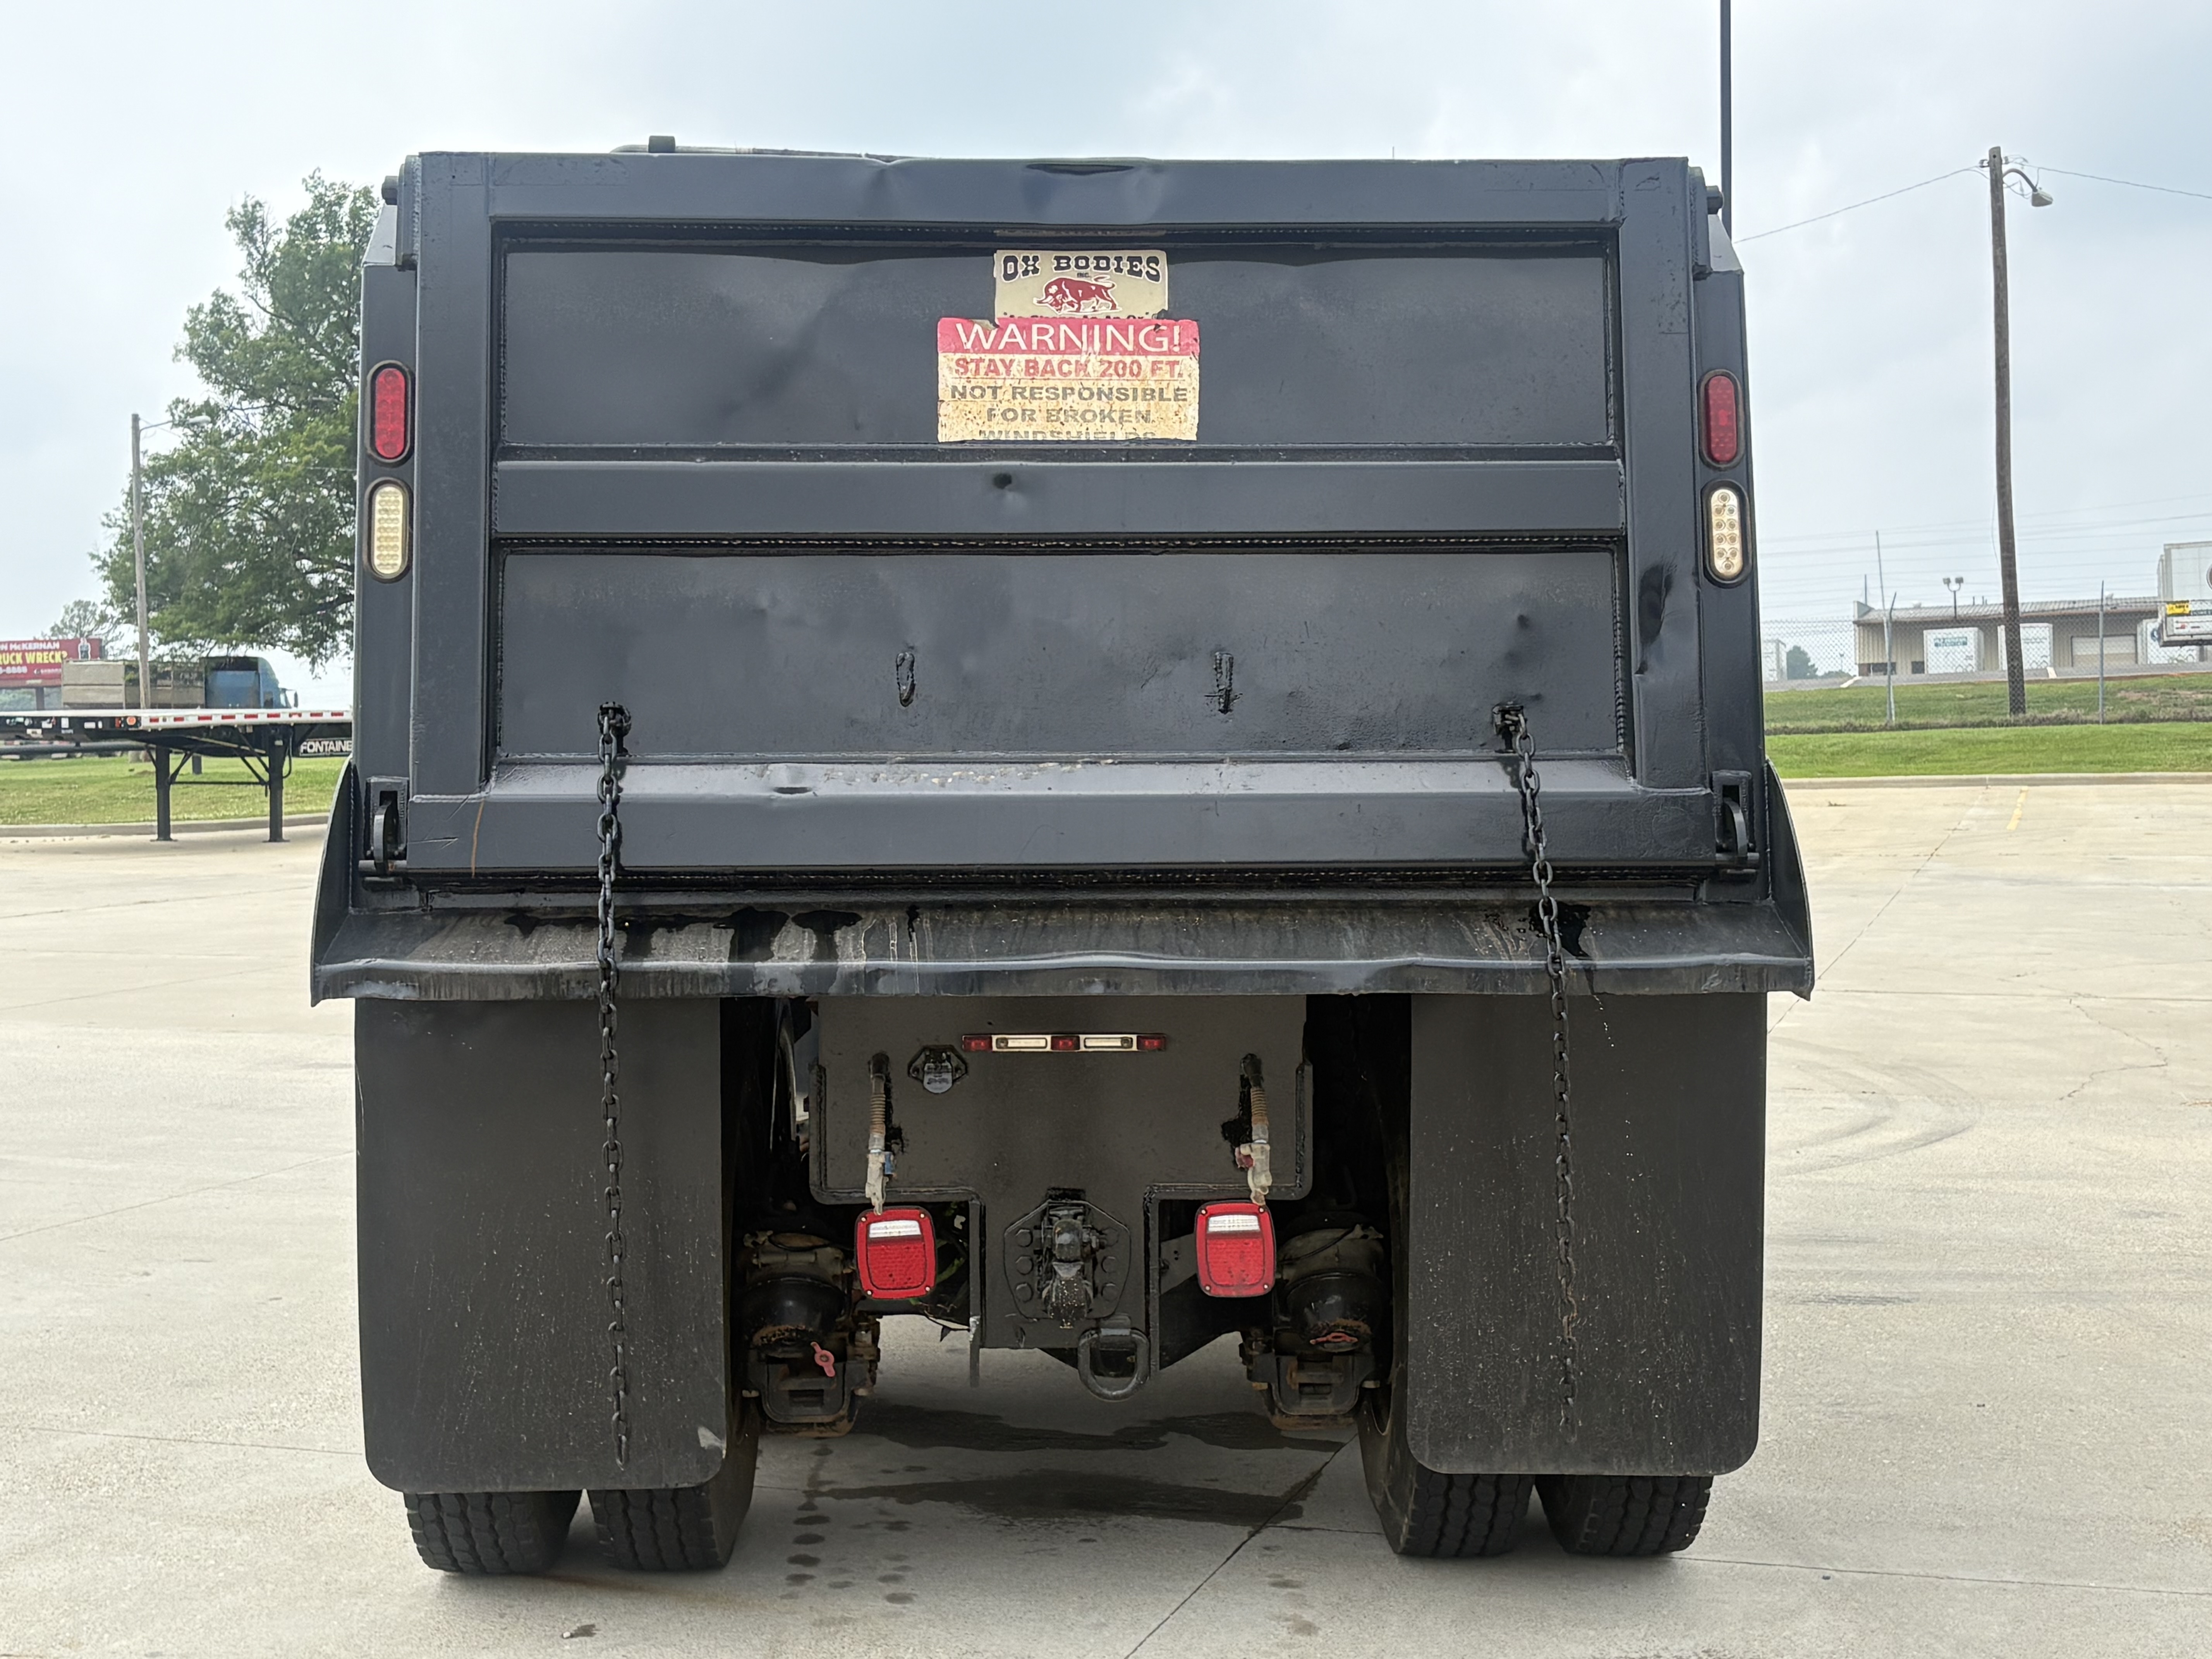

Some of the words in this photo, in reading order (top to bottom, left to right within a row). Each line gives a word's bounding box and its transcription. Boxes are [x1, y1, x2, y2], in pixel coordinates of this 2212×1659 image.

[1003, 255, 1040, 281] OX
[1053, 255, 1160, 282] BODIES
[955, 323, 1180, 352] WARNING!
[955, 357, 1015, 376] STAY
[1024, 359, 1091, 377] BACK
[1100, 359, 1142, 378] 200
[1151, 360, 1183, 378] FT.
[951, 385, 1002, 399] NOT
[1012, 386, 1188, 402] RESPONSIBLE
[987, 407, 1036, 422] FOR
[1046, 409, 1151, 424] BROKEN
[300, 740, 353, 753] FONTAINE
